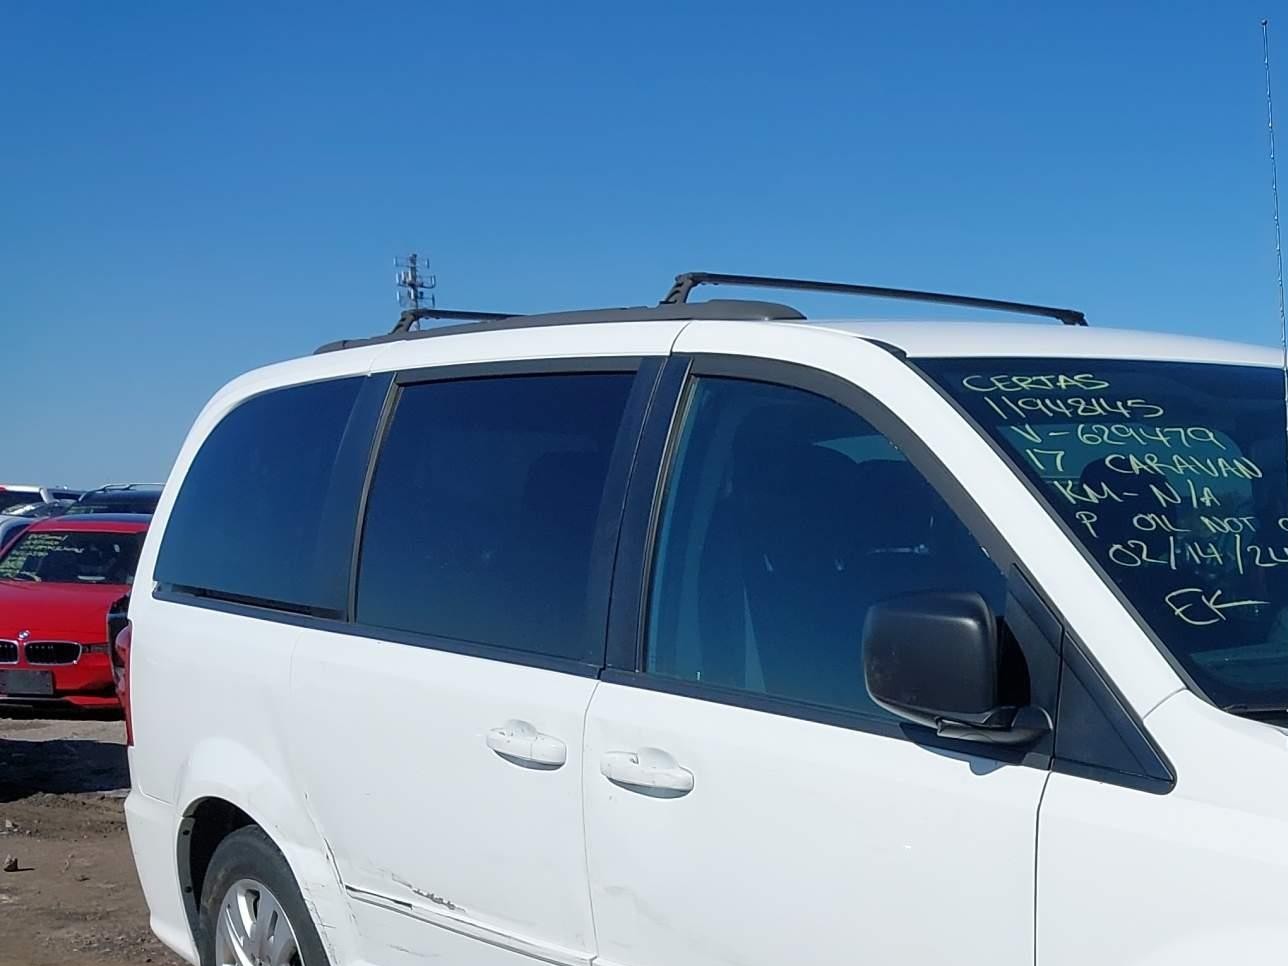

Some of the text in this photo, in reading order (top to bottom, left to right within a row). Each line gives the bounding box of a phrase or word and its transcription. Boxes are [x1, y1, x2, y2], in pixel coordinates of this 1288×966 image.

[963, 373, 1110, 392] CERTAS
[984, 395, 1164, 420] 11948145
[1026, 448, 1264, 479] 17 CARAVAN
[1075, 511, 1099, 538] P
[1133, 513, 1192, 533] OIL
[1200, 516, 1256, 533] NOT
